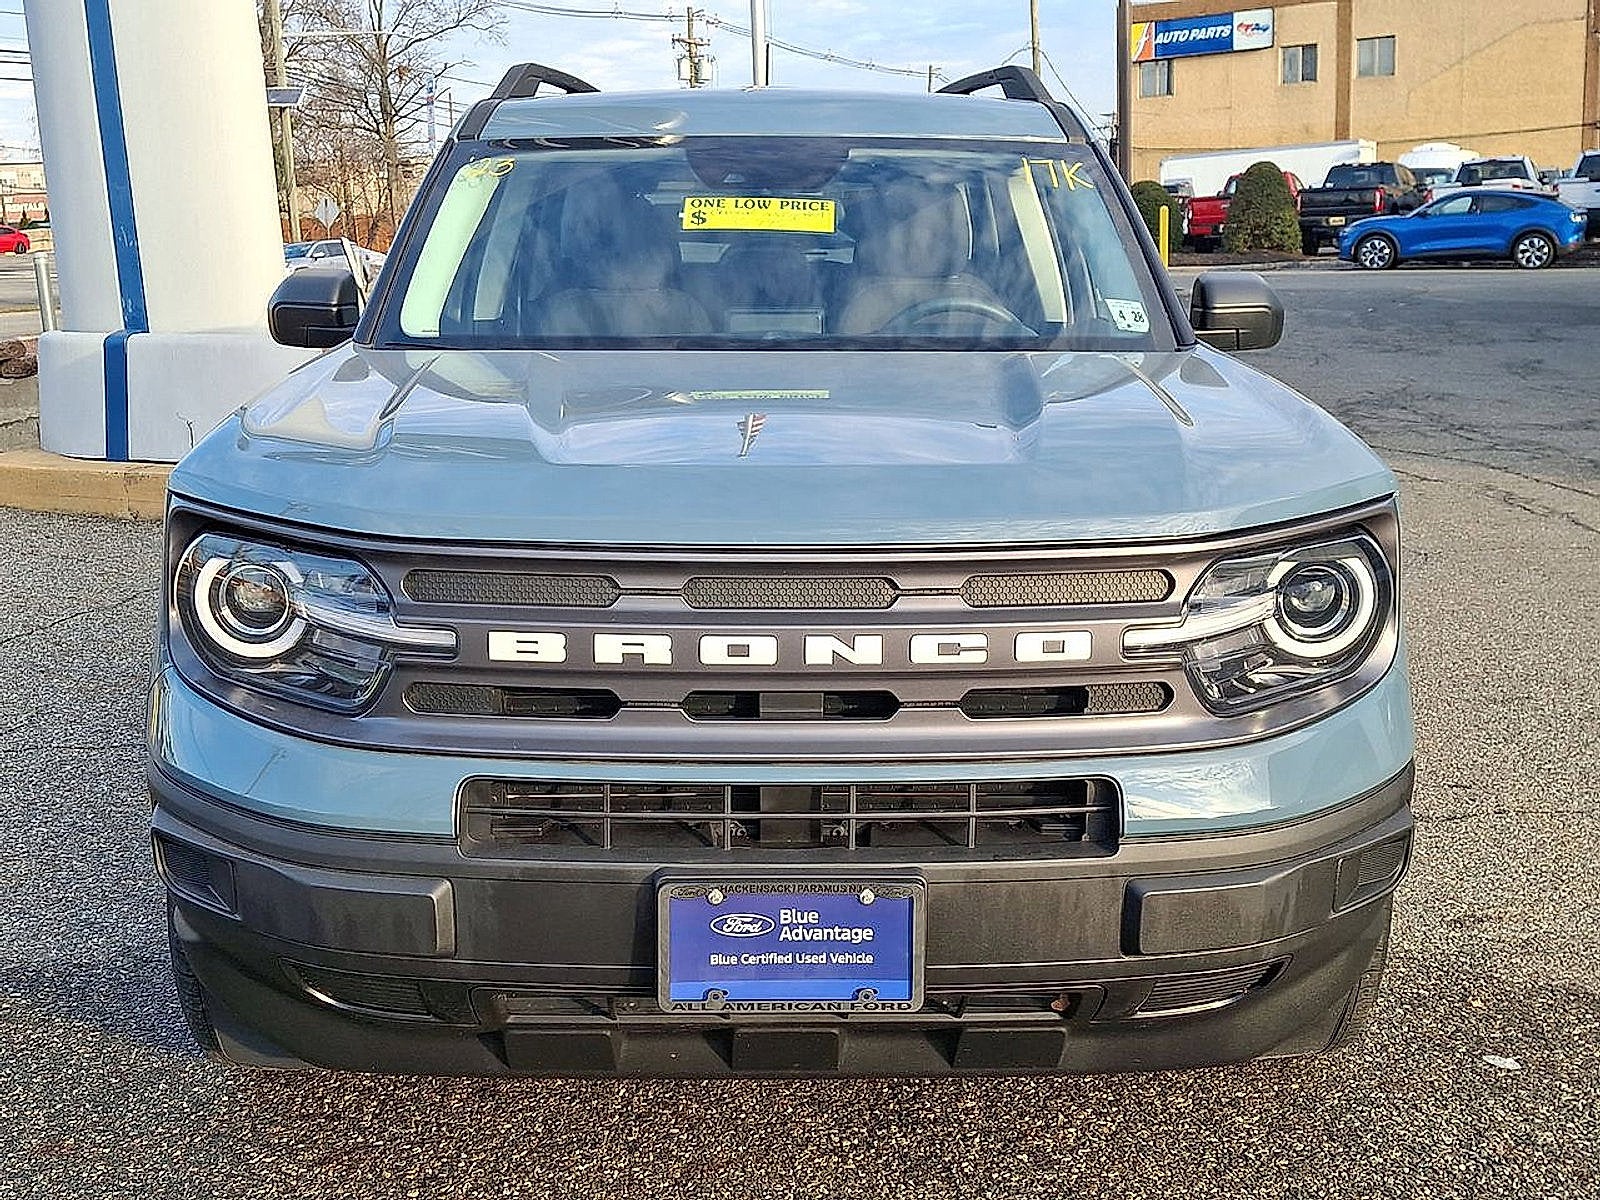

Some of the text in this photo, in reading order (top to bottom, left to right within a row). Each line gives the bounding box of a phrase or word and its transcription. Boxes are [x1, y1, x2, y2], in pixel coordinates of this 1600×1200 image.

[1155, 29, 1188, 44] AUTO
[1189, 25, 1232, 41] PARTS
[690, 198, 830, 211] ONE LOW PRICE
[690, 210, 707, 226] $
[487, 631, 1093, 665] BRONCO
[779, 908, 819, 924] Blue
[722, 916, 763, 934] Ford
[779, 926, 874, 943] Advantage
[710, 952, 874, 965] Blue Certified Used Vehicle
[671, 1002, 912, 1011] ALL AMERICAN FORD
